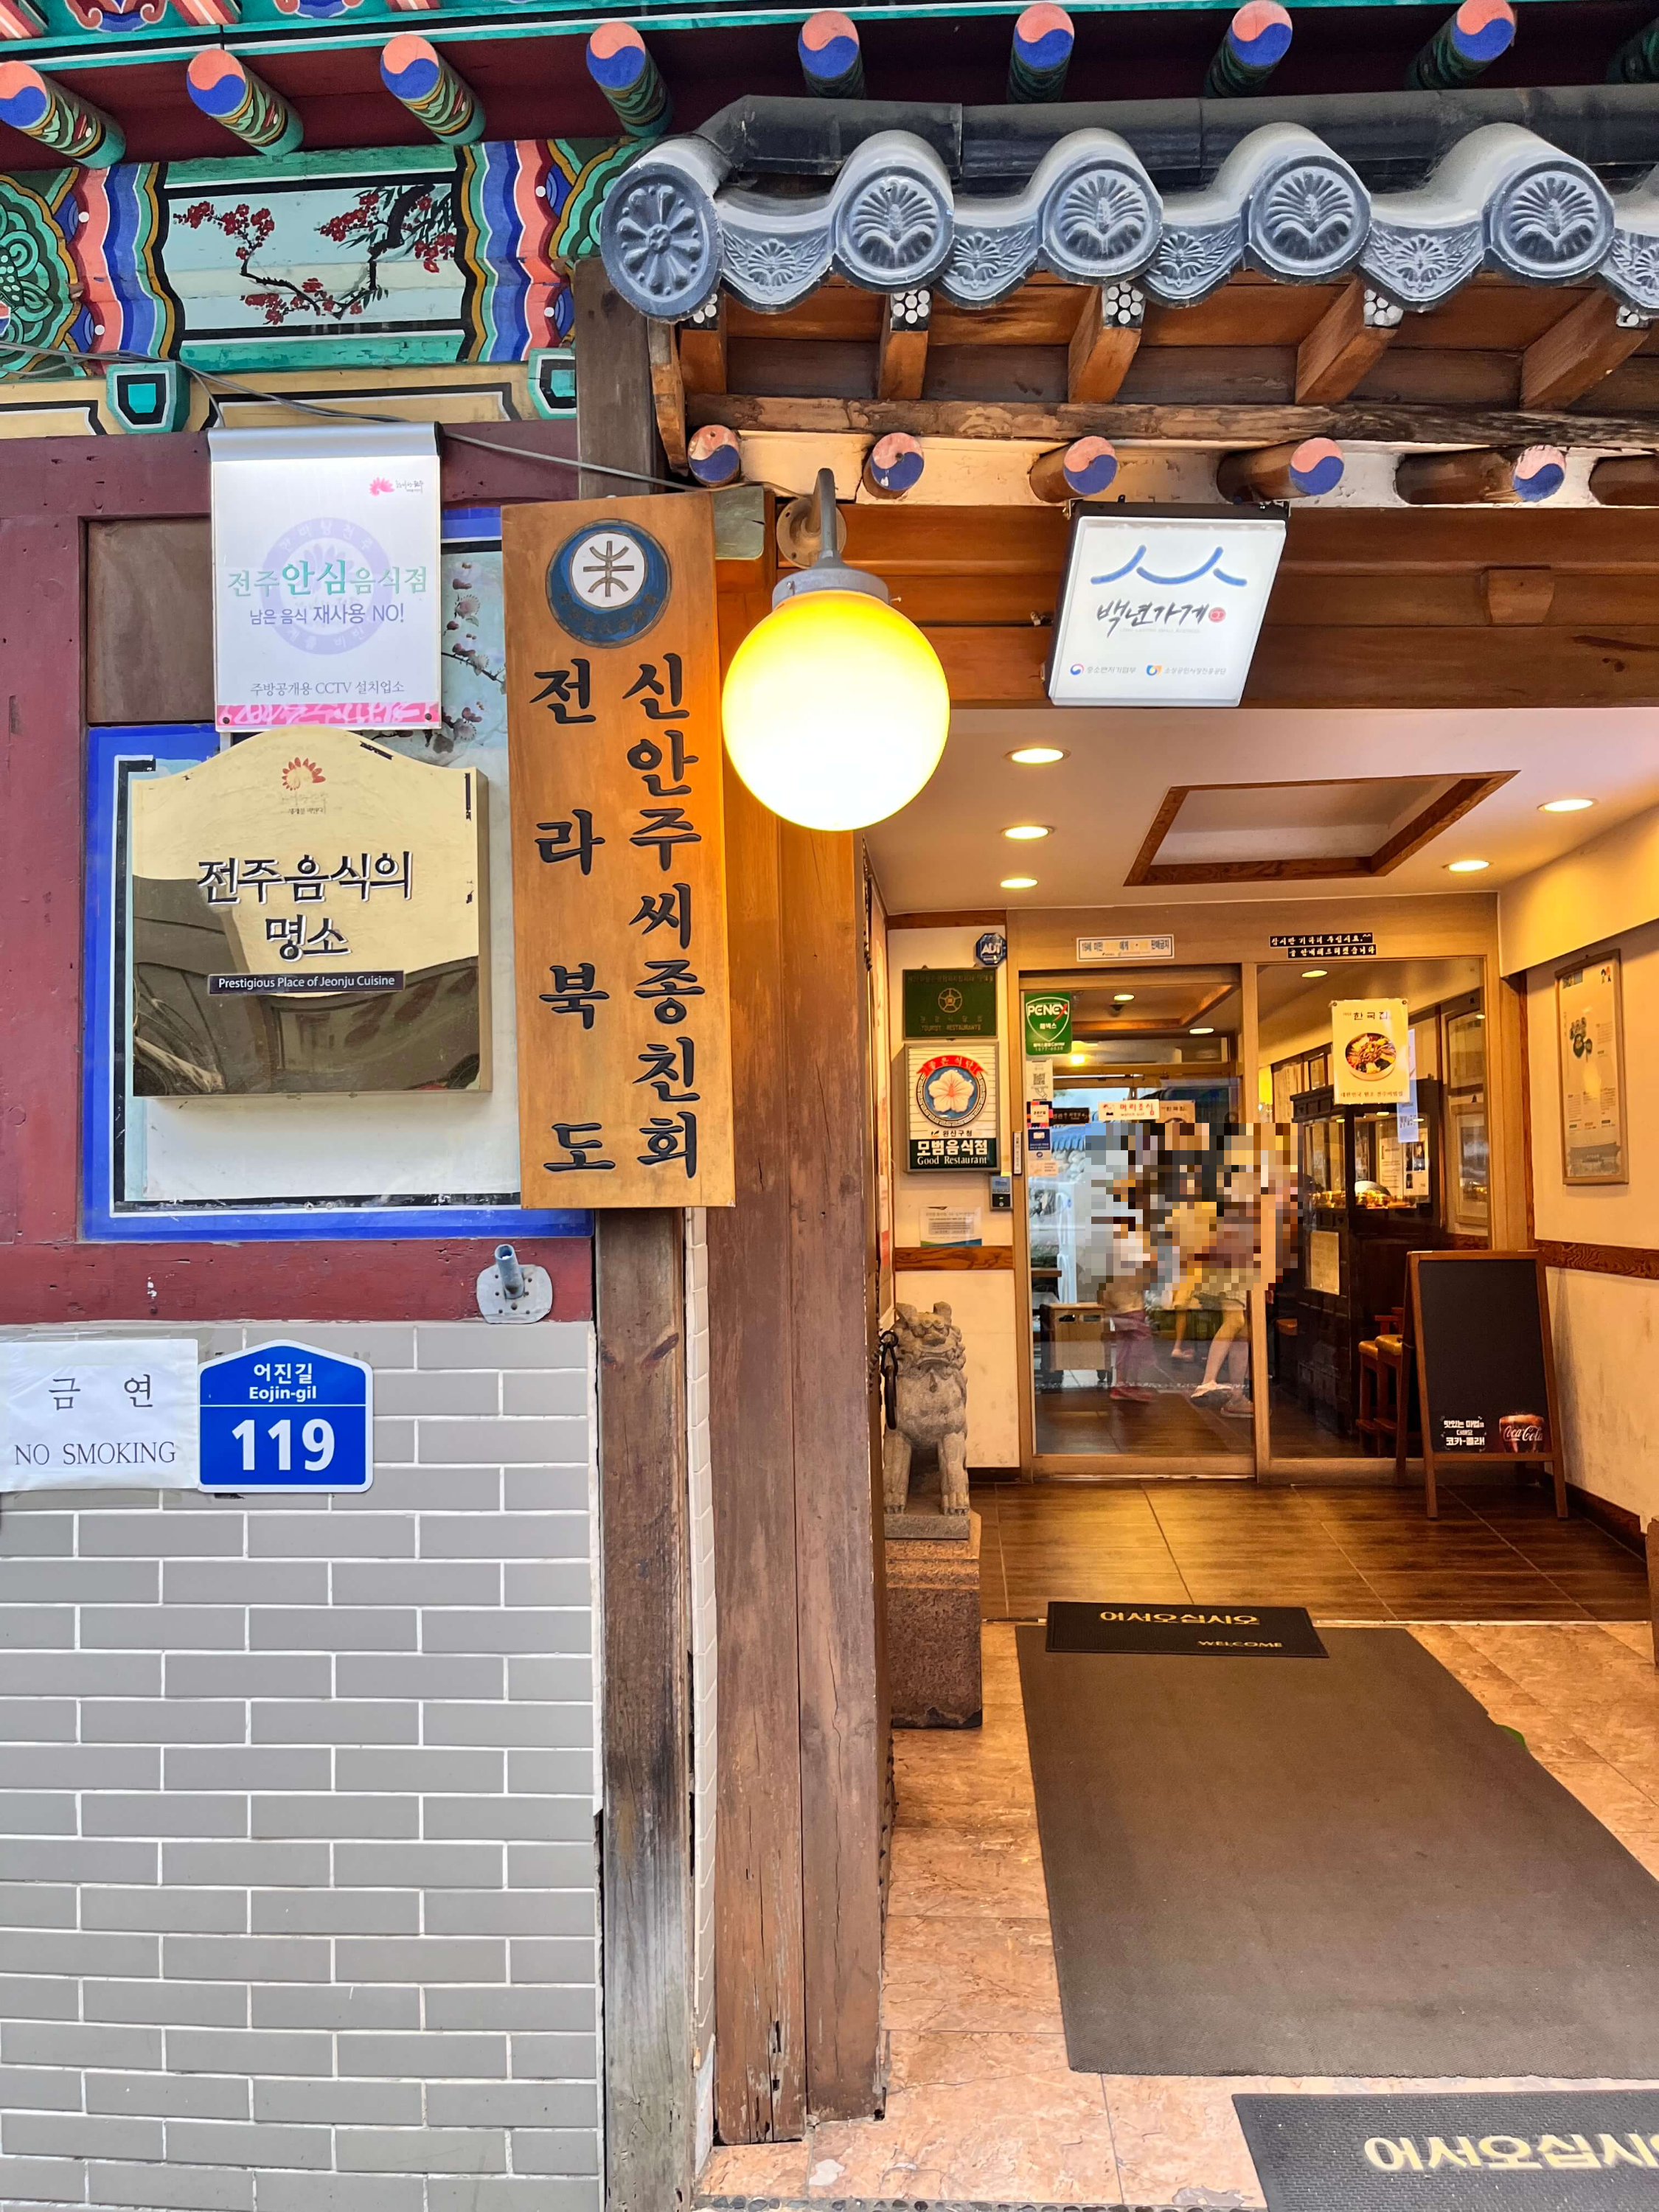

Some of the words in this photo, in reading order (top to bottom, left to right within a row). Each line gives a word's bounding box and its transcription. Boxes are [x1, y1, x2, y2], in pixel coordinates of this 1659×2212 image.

[250, 609, 276, 625] 남은
[281, 608, 307, 625] 음식
[313, 603, 366, 625] 재사용
[372, 602, 404, 623] NO!
[1096, 599, 1209, 638] 백년가게
[251, 682, 313, 696] 주방공개용
[316, 681, 352, 695] CCTV
[355, 680, 405, 695] 설치업소
[198, 851, 412, 905] 전주음식의
[265, 914, 352, 961] 명소
[1298, 936, 1323, 945] 기다려
[218, 976, 275, 990] Prestigious
[277, 976, 305, 988] Place
[307, 975, 318, 987] of
[319, 975, 354, 990] Jeonju
[357, 975, 395, 987] Cuisine
[1027, 1004, 1068, 1018] PENEX
[1353, 1012, 1388, 1020] 한국집
[917, 1140, 987, 1156] 모범음식점
[917, 1156, 939, 1165] Good
[944, 1156, 987, 1164] Restaurant
[254, 1363, 313, 1384] 어진길
[249, 1385, 317, 1402] Eojin-gil
[232, 1418, 335, 1471] 119
[15, 1443, 50, 1466] NO
[63, 1441, 176, 1466] SMOKING
[1100, 1611, 1260, 1626] 어서오십시오
[1364, 2133, 1659, 2171] 어서오십시
